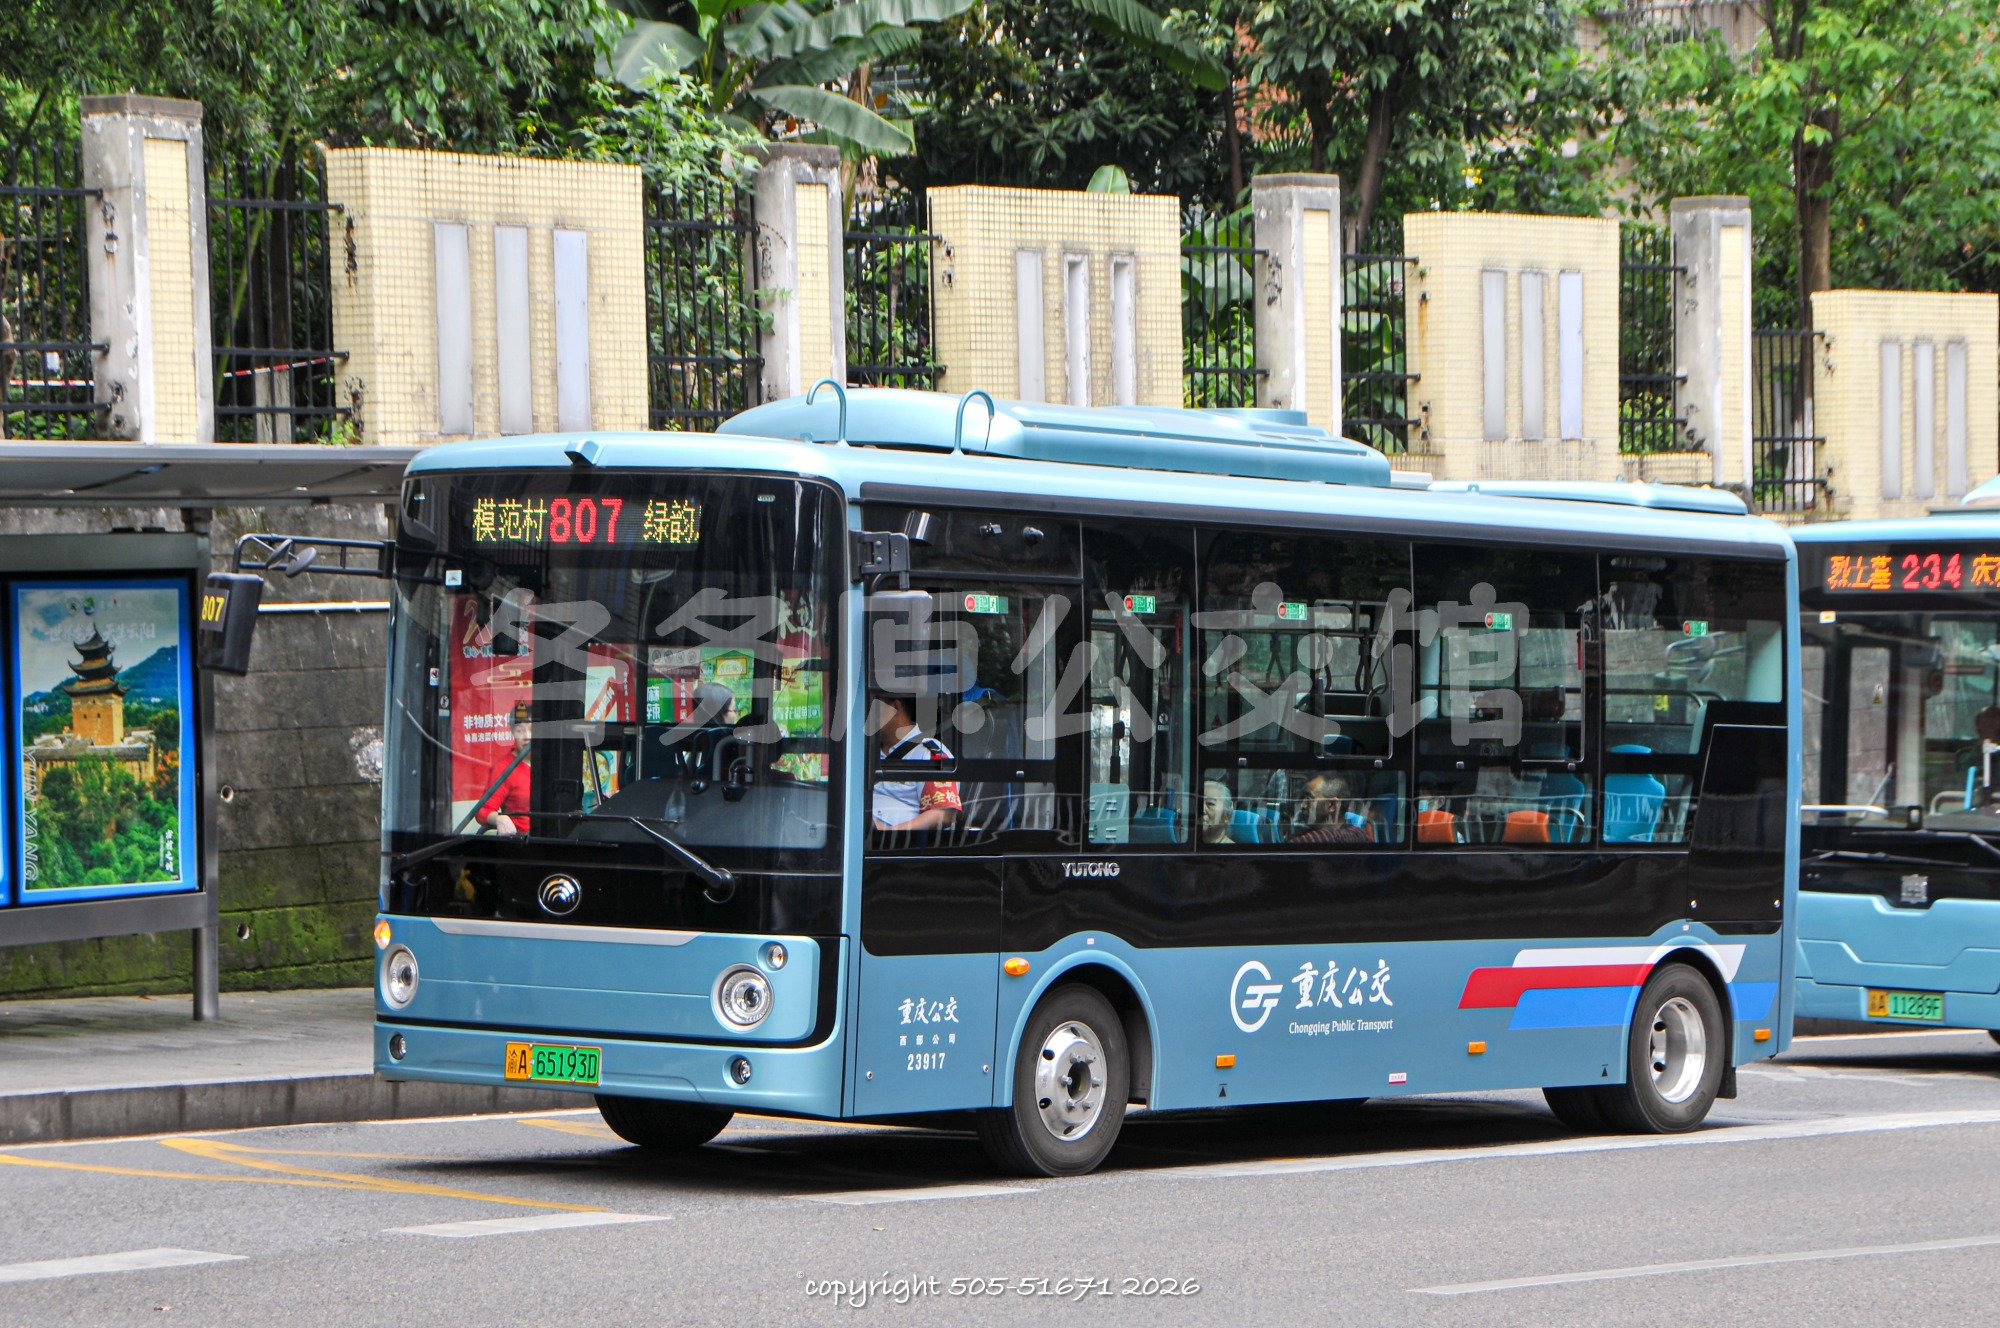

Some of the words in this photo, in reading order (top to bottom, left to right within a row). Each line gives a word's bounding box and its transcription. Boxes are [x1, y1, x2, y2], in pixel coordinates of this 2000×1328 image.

[473, 498, 547, 542] 模范村
[550, 498, 623, 543] 807
[1827, 555, 1892, 590] 烈士墓
[1901, 553, 1961, 590] 234
[1971, 553, 2000, 588] 庆
[202, 595, 225, 622] 807
[24, 748, 37, 803] YUN
[25, 808, 39, 881] YANG
[1061, 862, 1120, 878] YUTONG
[1291, 958, 1394, 1010] 重庆公交
[897, 997, 960, 1025] 重庆公交
[1289, 1021, 1330, 1036] Chongqing
[1331, 1020, 1355, 1032] Public
[1357, 1018, 1393, 1034] Transport
[907, 1053, 946, 1071] 23917
